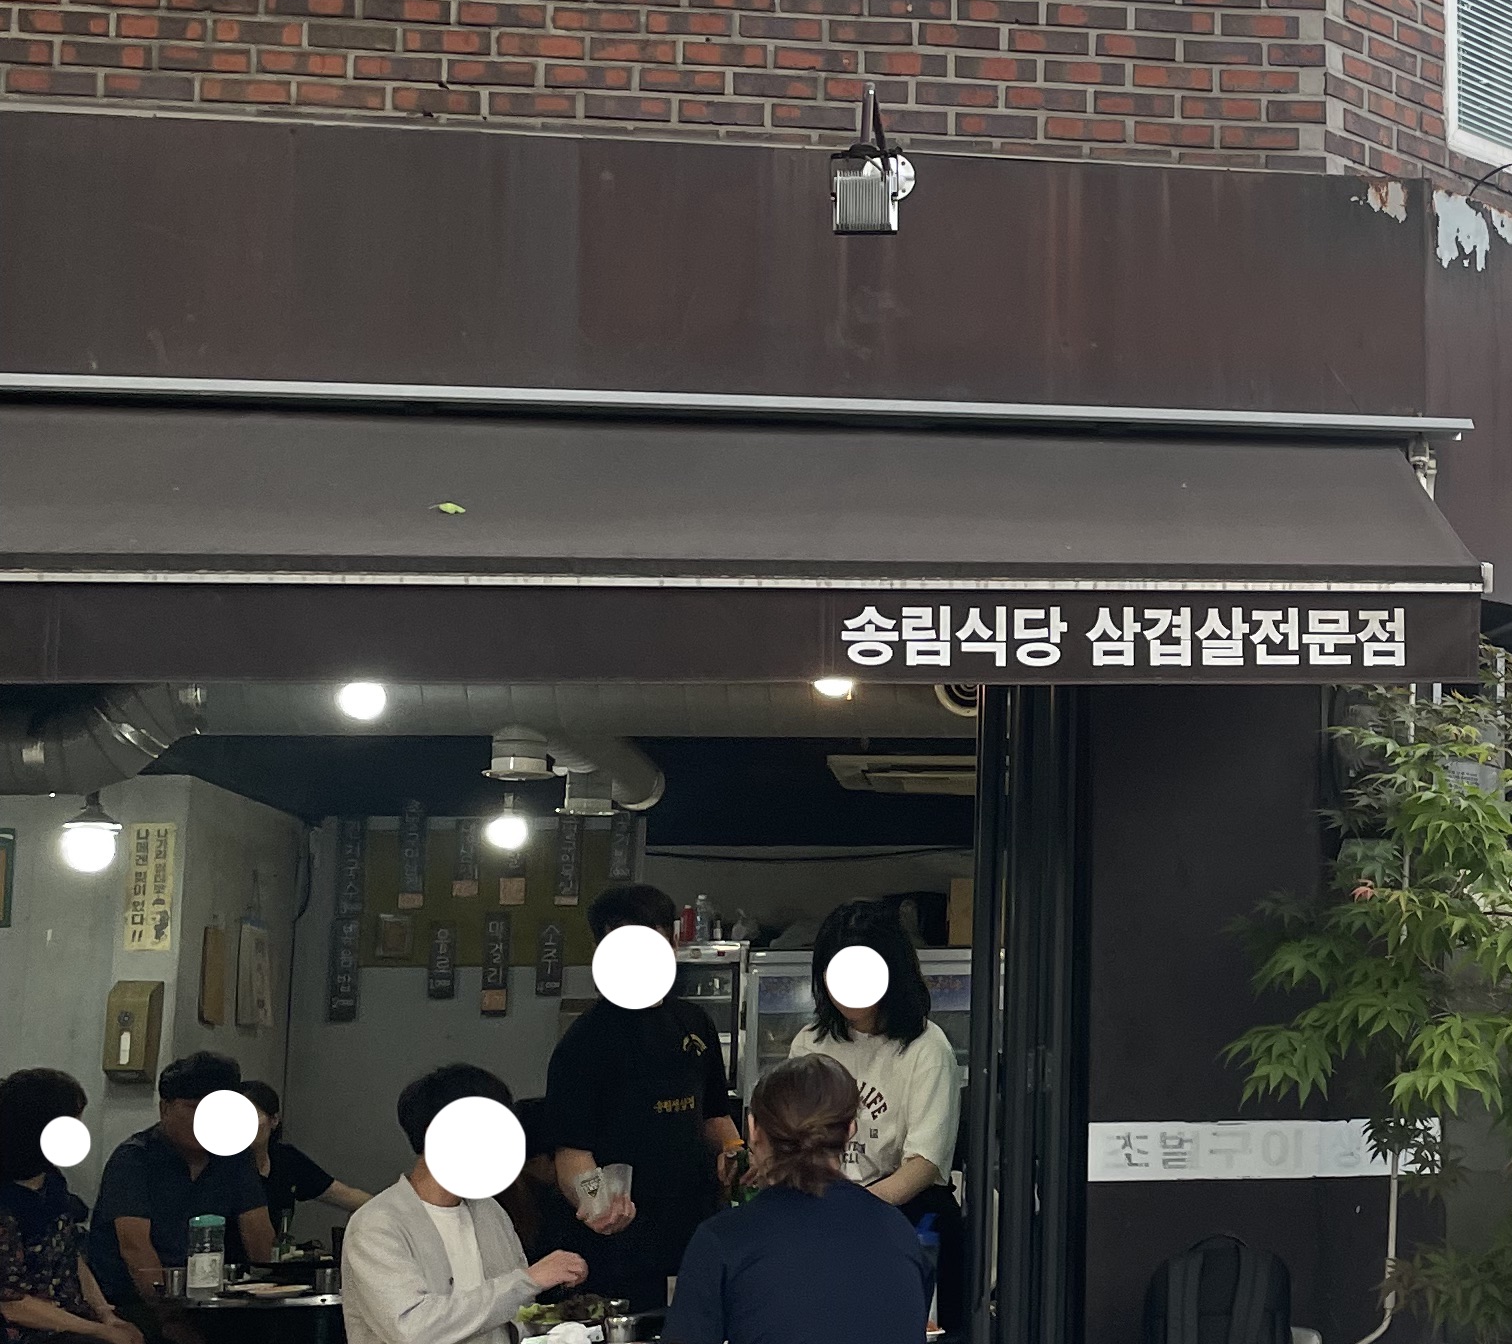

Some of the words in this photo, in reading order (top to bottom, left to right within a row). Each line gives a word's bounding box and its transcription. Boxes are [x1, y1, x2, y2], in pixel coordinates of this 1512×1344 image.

[841, 605, 1067, 666] 송림식당
[1086, 606, 1406, 666] 삼겹살전문점
[488, 920, 505, 984] 막걸리
[541, 924, 560, 974] 소주
